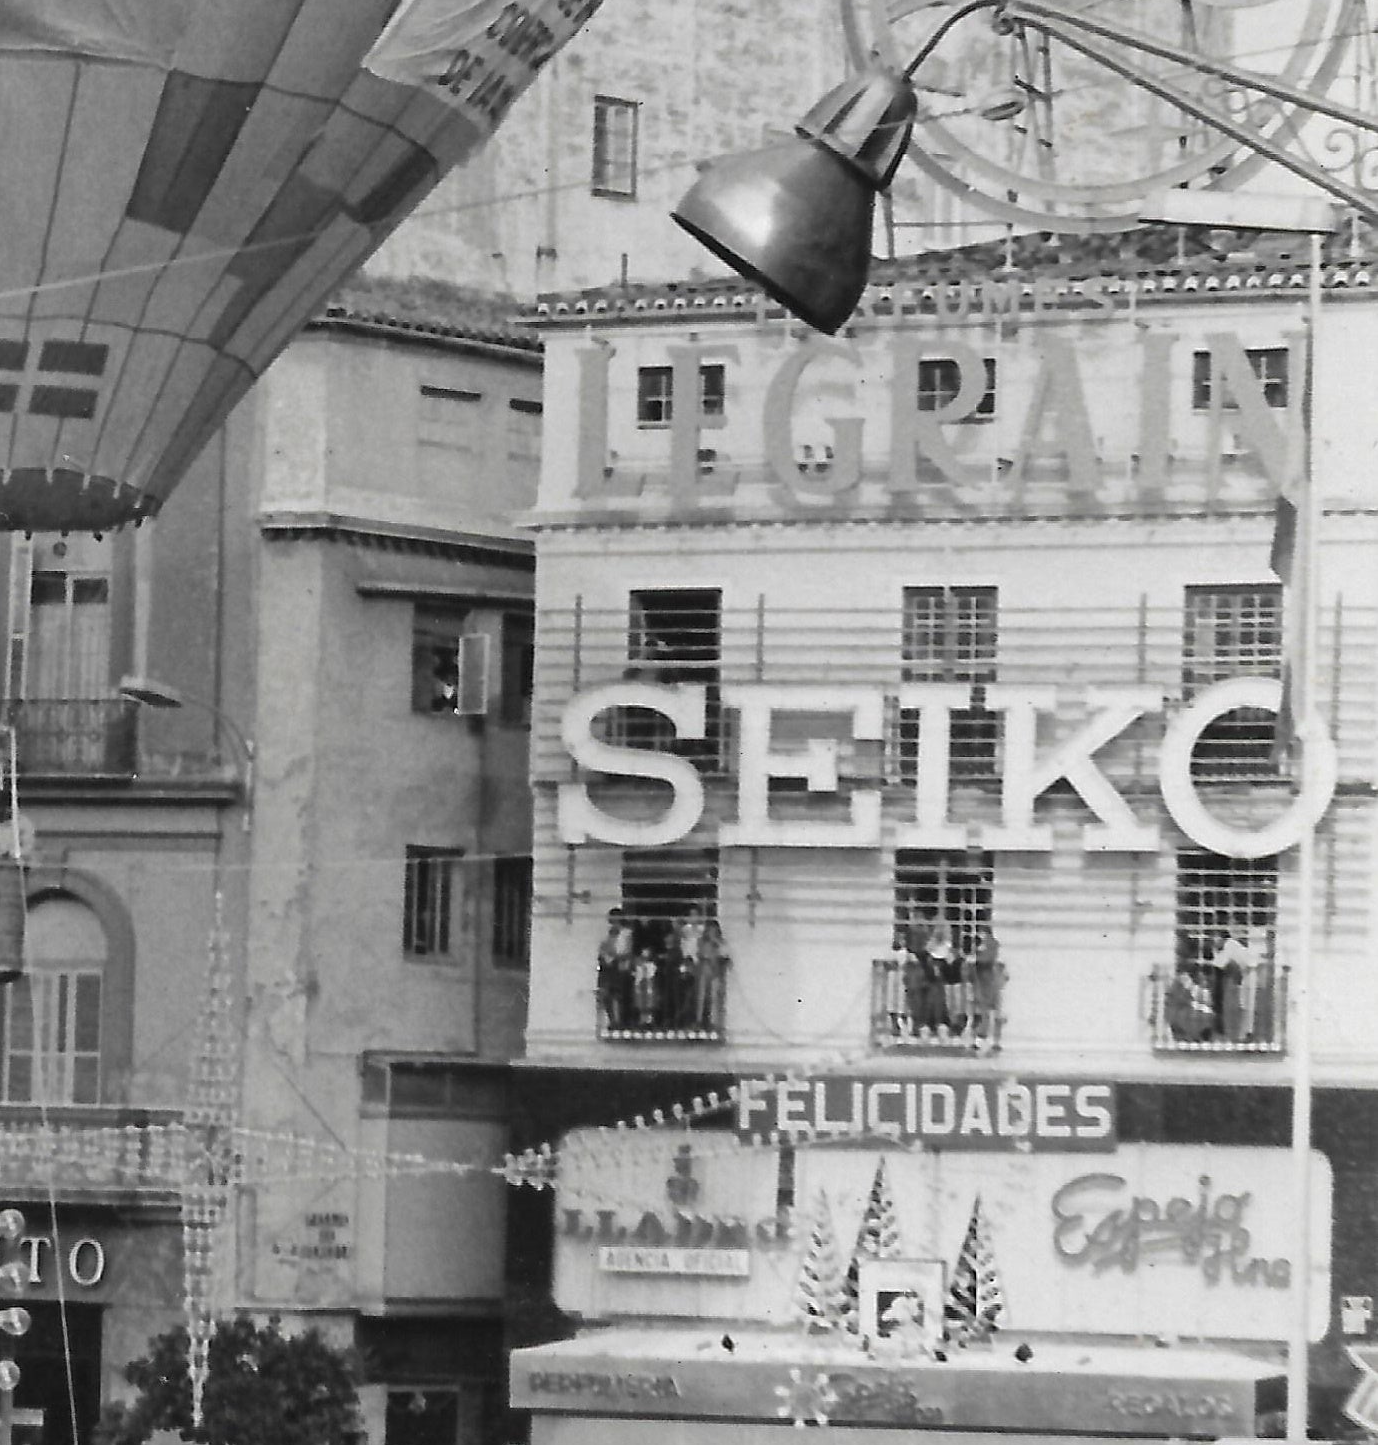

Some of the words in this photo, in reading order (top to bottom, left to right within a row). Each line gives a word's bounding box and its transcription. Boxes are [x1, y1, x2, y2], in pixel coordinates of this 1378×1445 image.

[573, 328, 1312, 497] LEGRAIN
[557, 675, 1337, 859] SEIKO
[739, 1078, 1112, 1138] FELICIDADES
